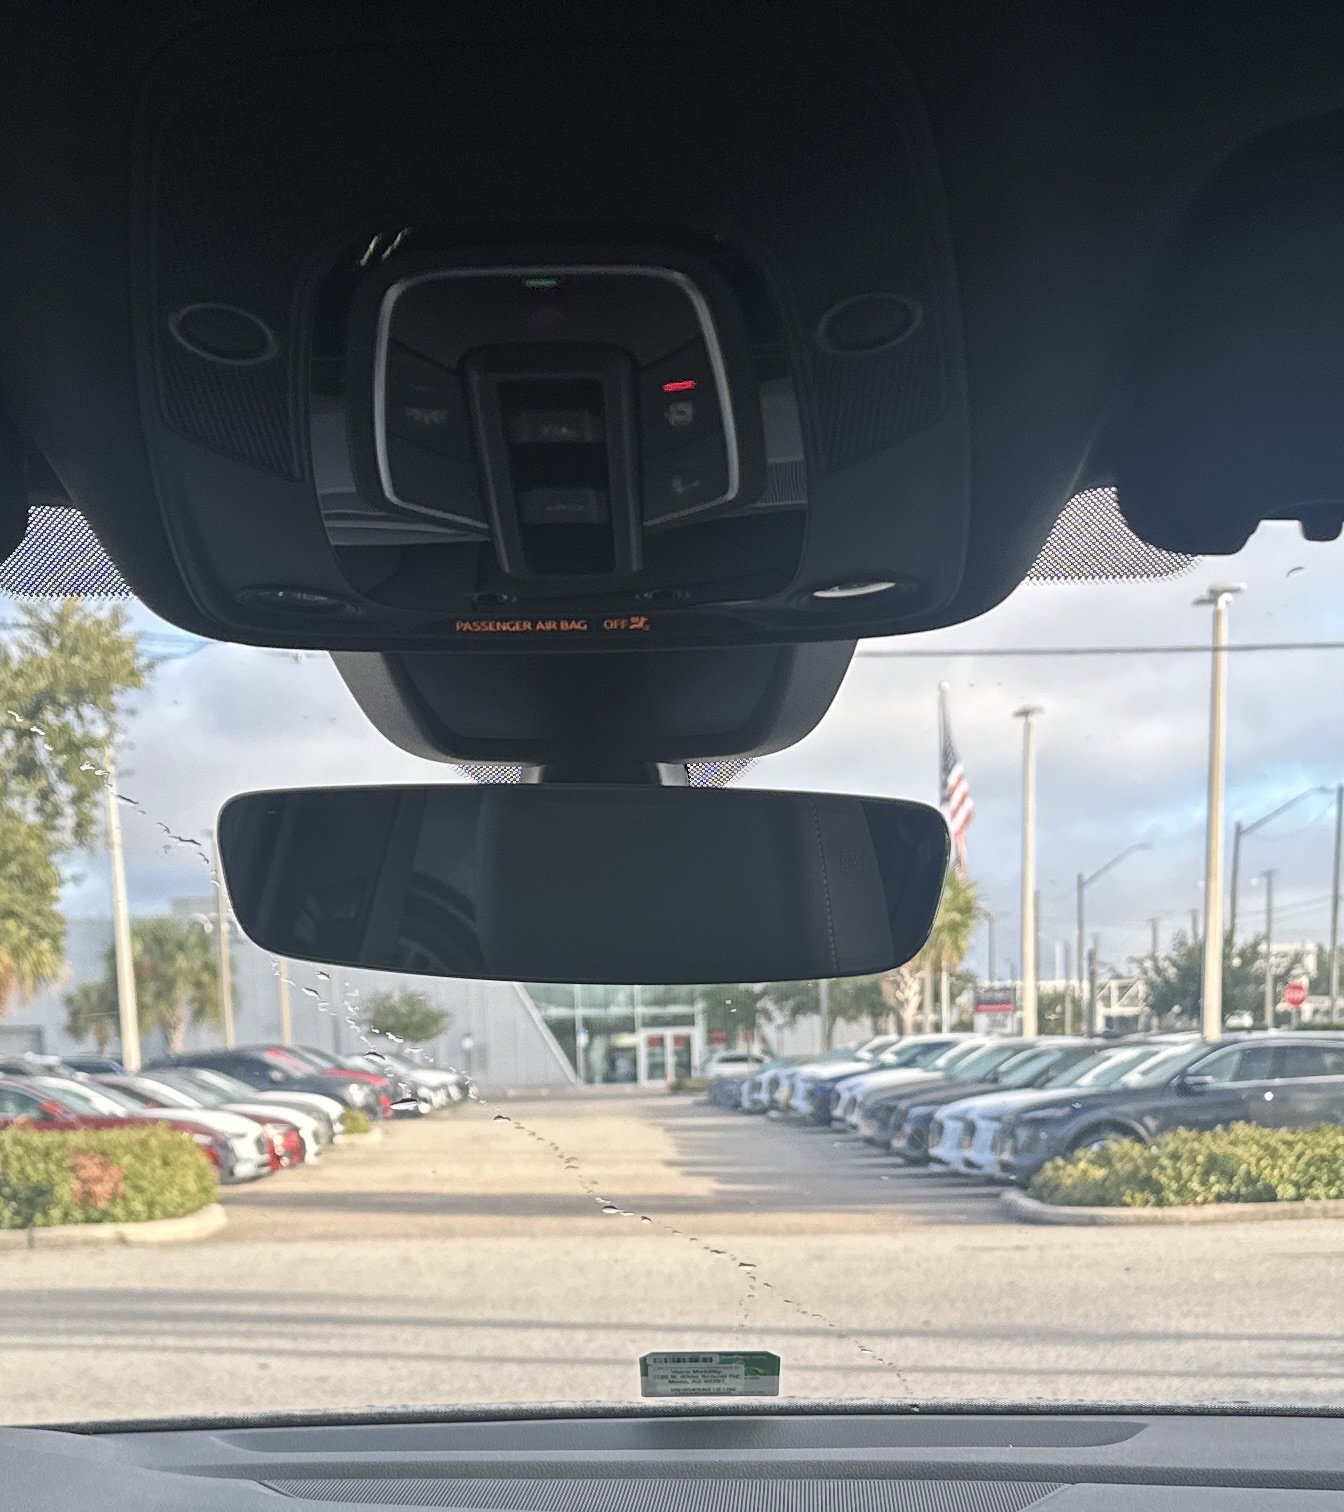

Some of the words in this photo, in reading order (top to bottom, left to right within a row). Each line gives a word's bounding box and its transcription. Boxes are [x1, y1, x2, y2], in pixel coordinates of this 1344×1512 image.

[456, 619, 532, 632] PASSENGER
[535, 619, 557, 631] AIR
[560, 619, 587, 631] BAG
[603, 618, 628, 630] OFF
